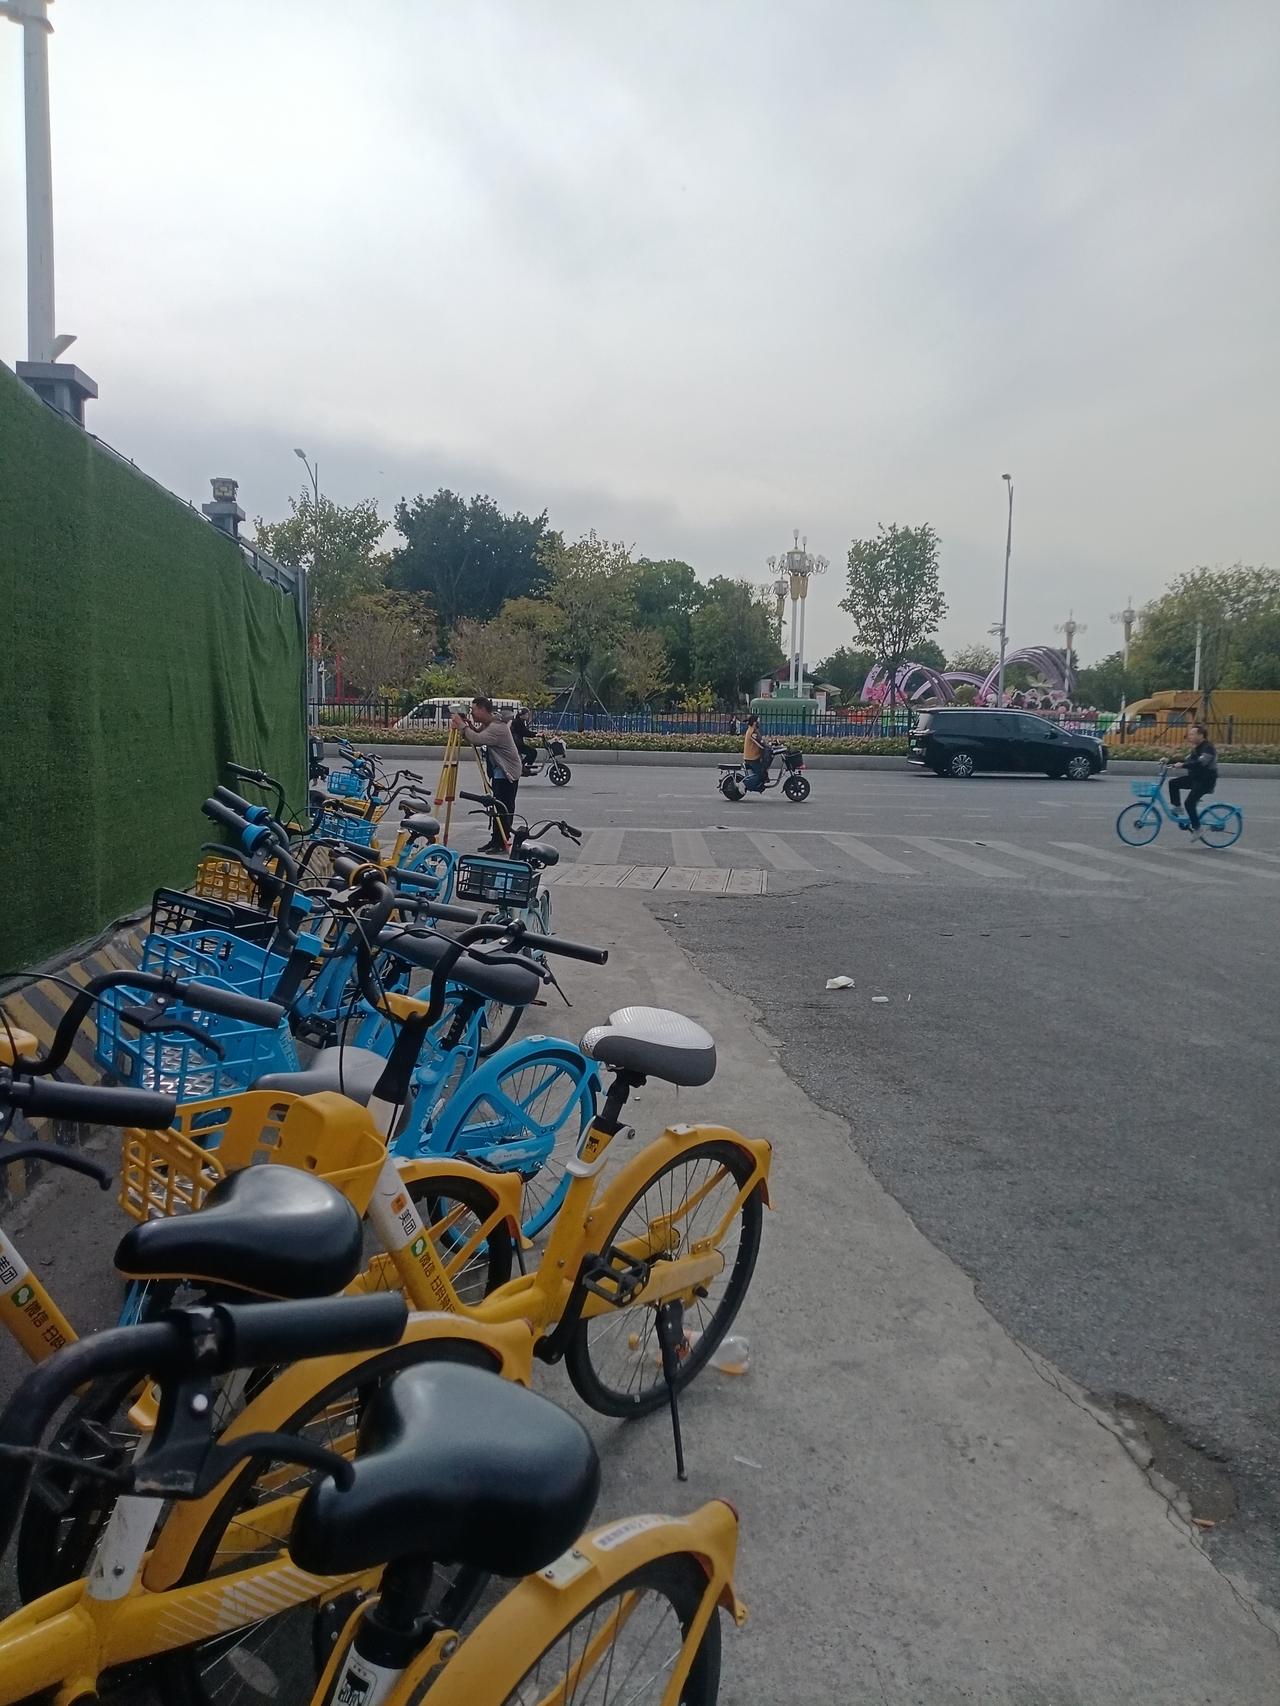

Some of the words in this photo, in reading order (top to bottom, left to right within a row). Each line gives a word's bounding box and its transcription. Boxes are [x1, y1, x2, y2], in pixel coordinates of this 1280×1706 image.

[399, 1208, 417, 1236] 美团
[419, 1251, 435, 1278] 微信
[23, 1300, 49, 1328] 微信
